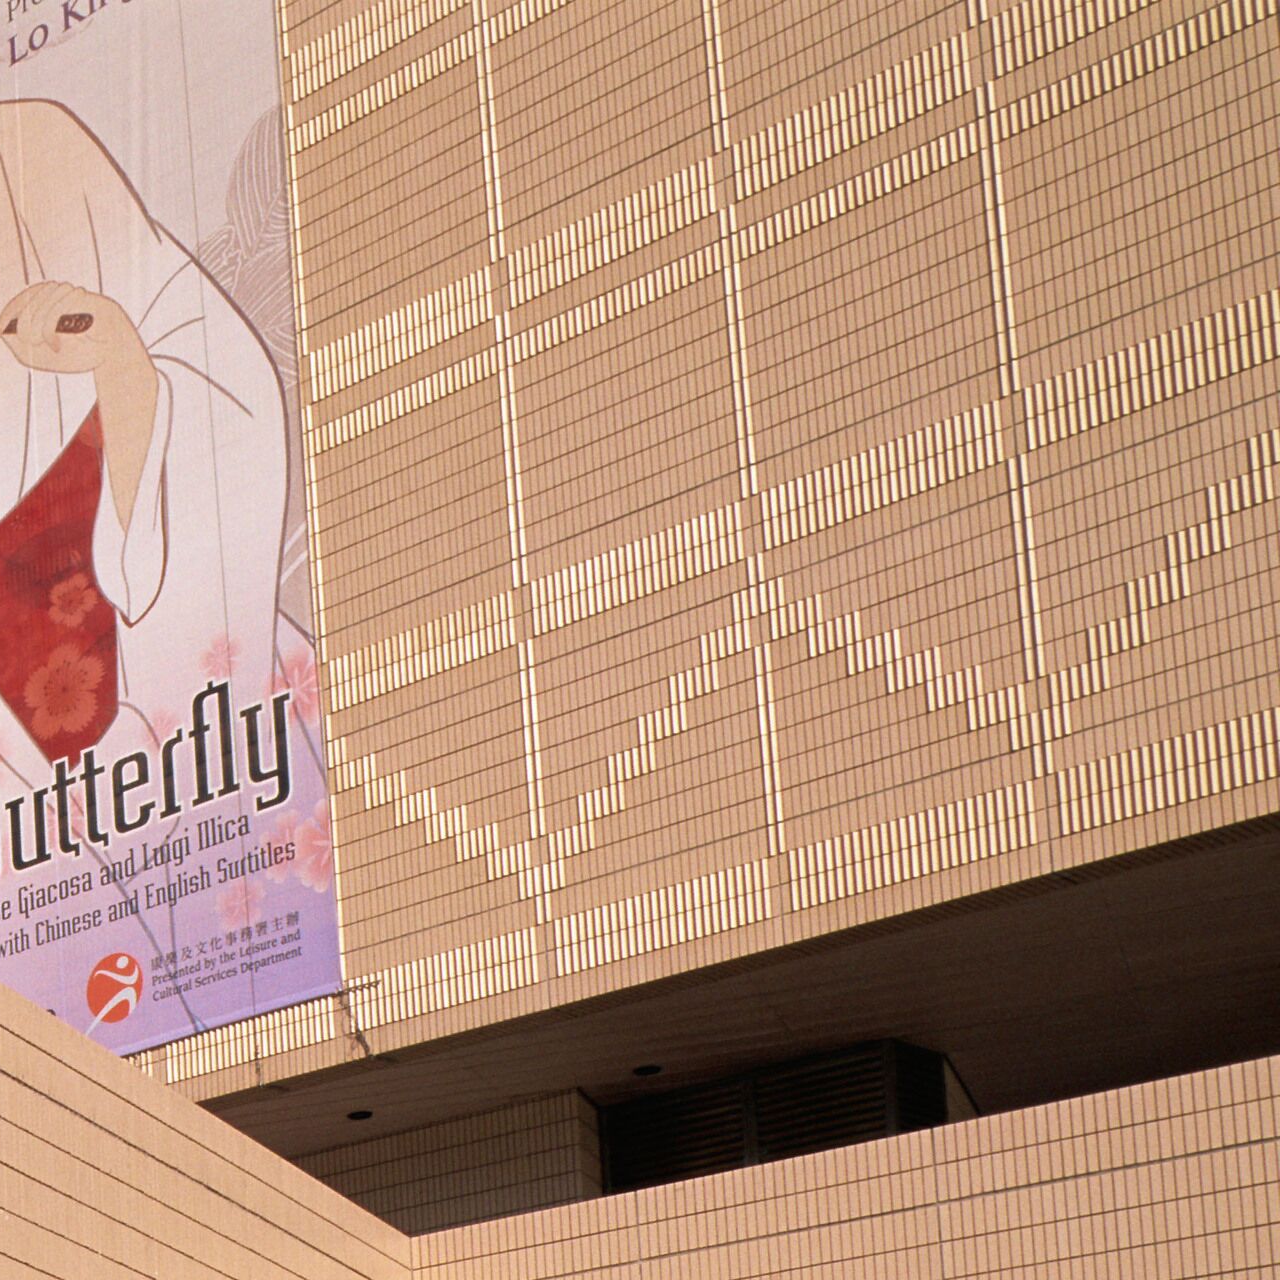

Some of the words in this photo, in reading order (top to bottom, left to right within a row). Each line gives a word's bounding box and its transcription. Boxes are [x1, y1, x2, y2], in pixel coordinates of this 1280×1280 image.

[18, 871, 93, 919] Giacosa
[100, 849, 137, 886] and
[142, 827, 191, 871] Luigi
[197, 813, 251, 852] Illica
[35, 906, 102, 947] Chinese
[108, 888, 139, 923] and
[145, 866, 211, 911] English
[217, 838, 296, 884] Surtitles
[151, 959, 201, 987] Presented
[204, 957, 217, 973] by
[219, 951, 236, 965] the
[240, 938, 278, 958] Leisure
[280, 928, 301, 946] and
[152, 978, 193, 1002] Cultural
[194, 966, 238, 988] Services
[240, 945, 303, 974] Department
